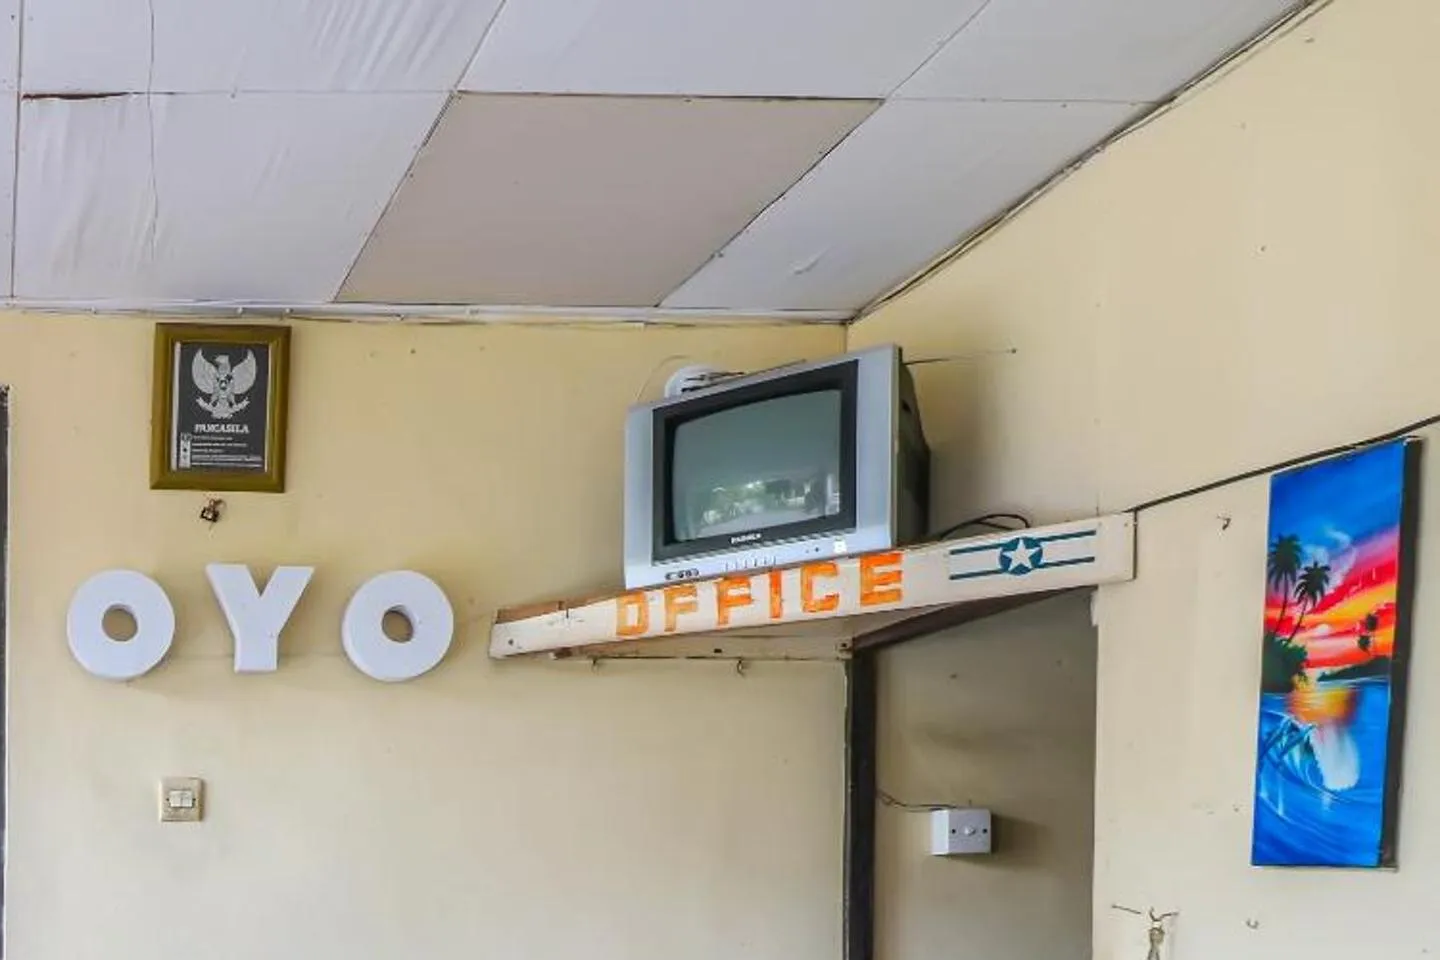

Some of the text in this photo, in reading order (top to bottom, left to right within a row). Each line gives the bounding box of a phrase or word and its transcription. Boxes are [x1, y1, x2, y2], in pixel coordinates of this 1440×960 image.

[194, 423, 250, 434] PANCASILA
[66, 563, 454, 682] OYO
[615, 551, 903, 639] OFFICE
